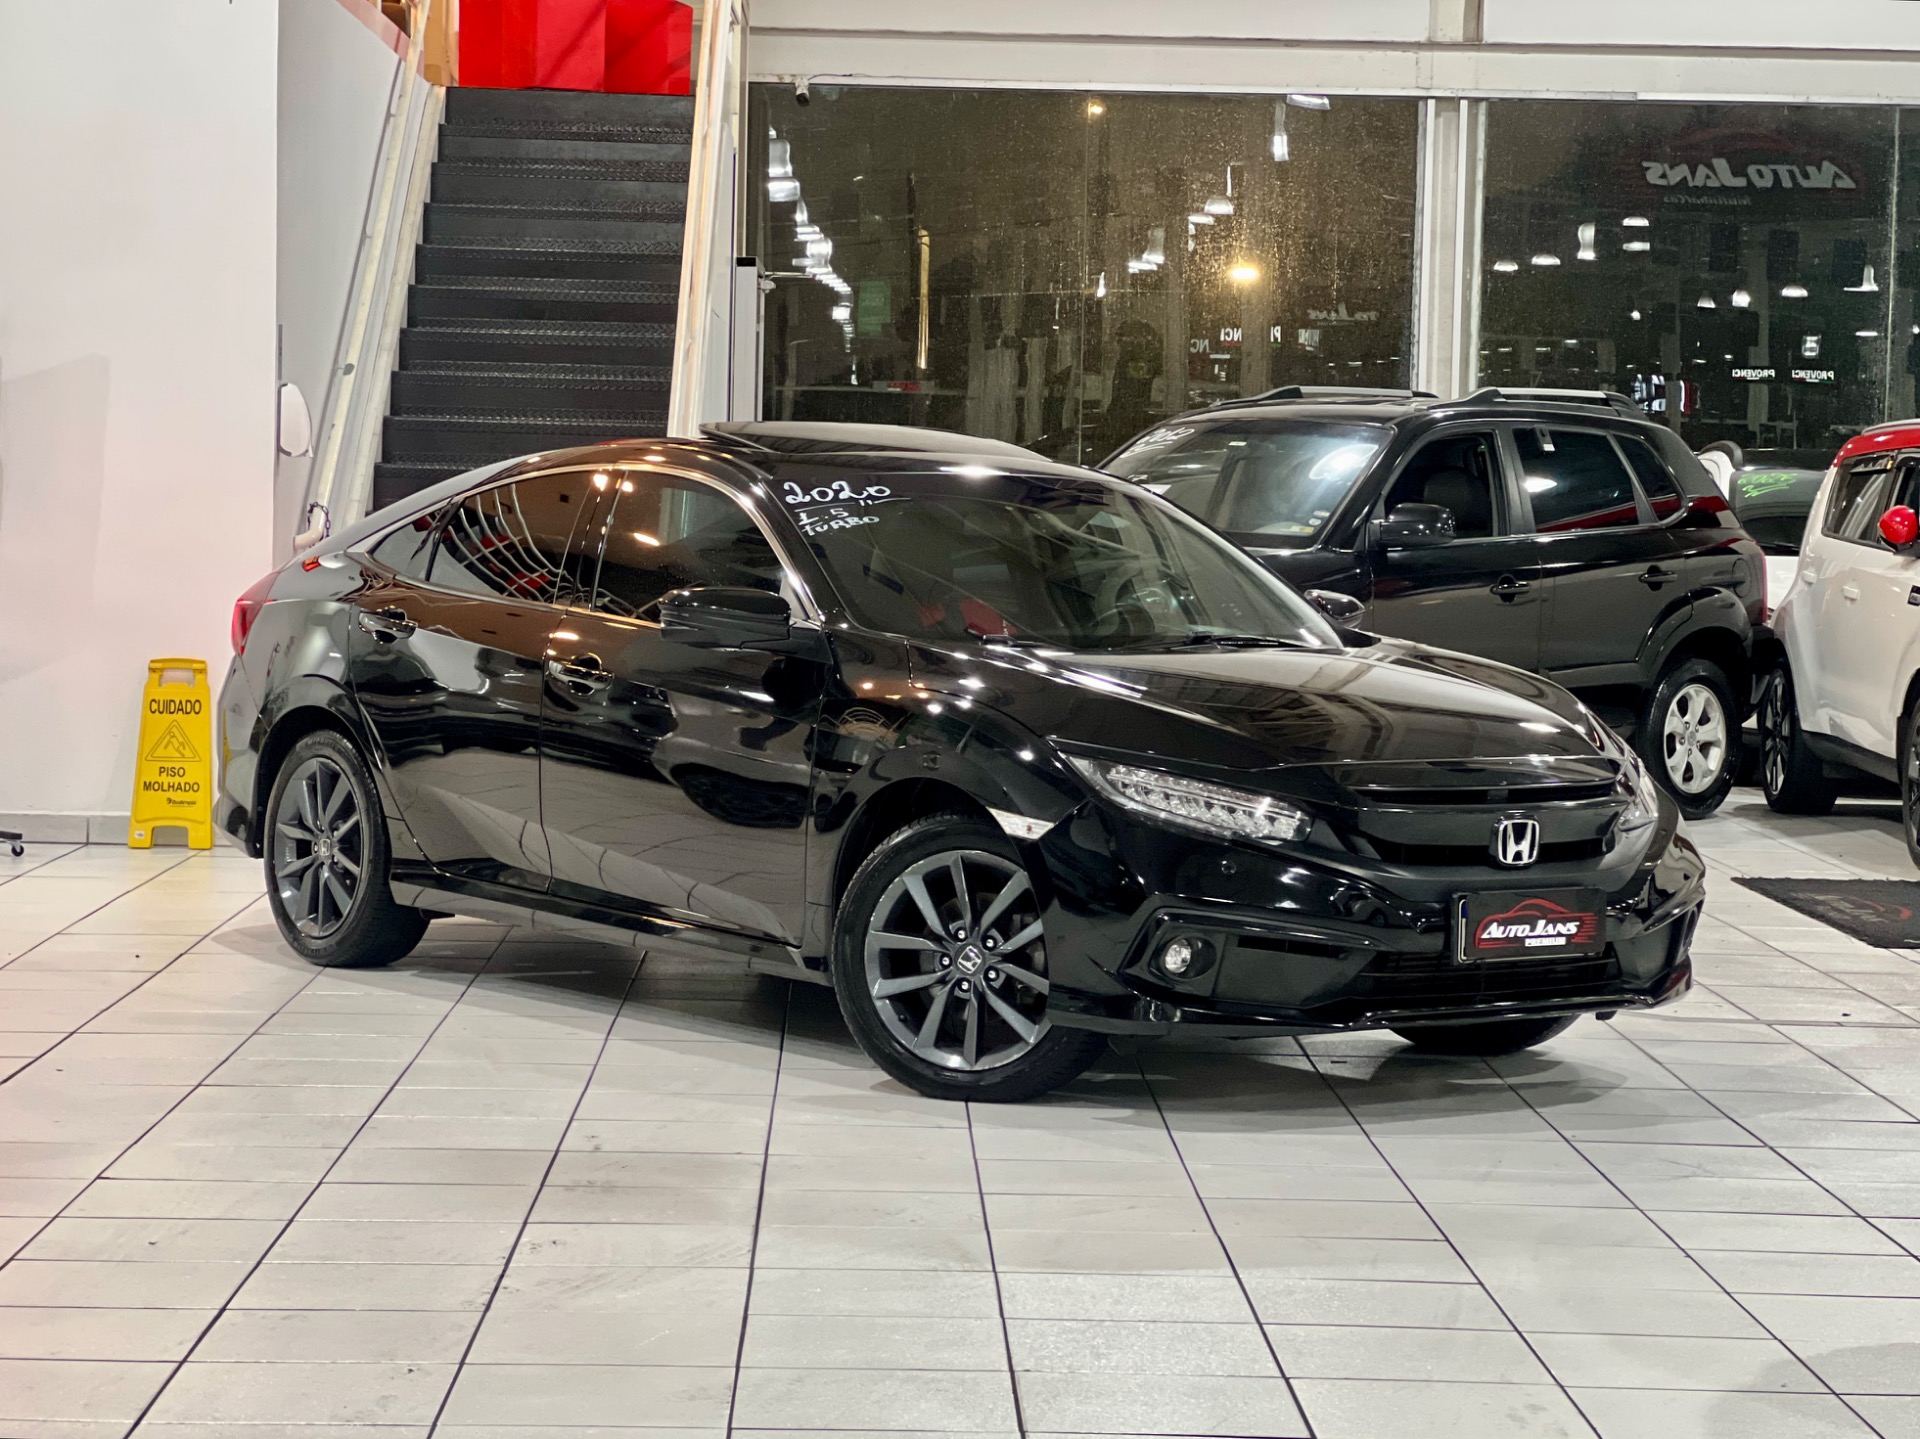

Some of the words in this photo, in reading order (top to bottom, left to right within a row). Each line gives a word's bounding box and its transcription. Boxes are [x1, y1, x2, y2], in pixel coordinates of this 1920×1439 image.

[783, 480, 891, 504] 2020
[149, 698, 202, 715] CUIDADO
[158, 766, 186, 778] PISO
[143, 781, 200, 793] MOLHADO
